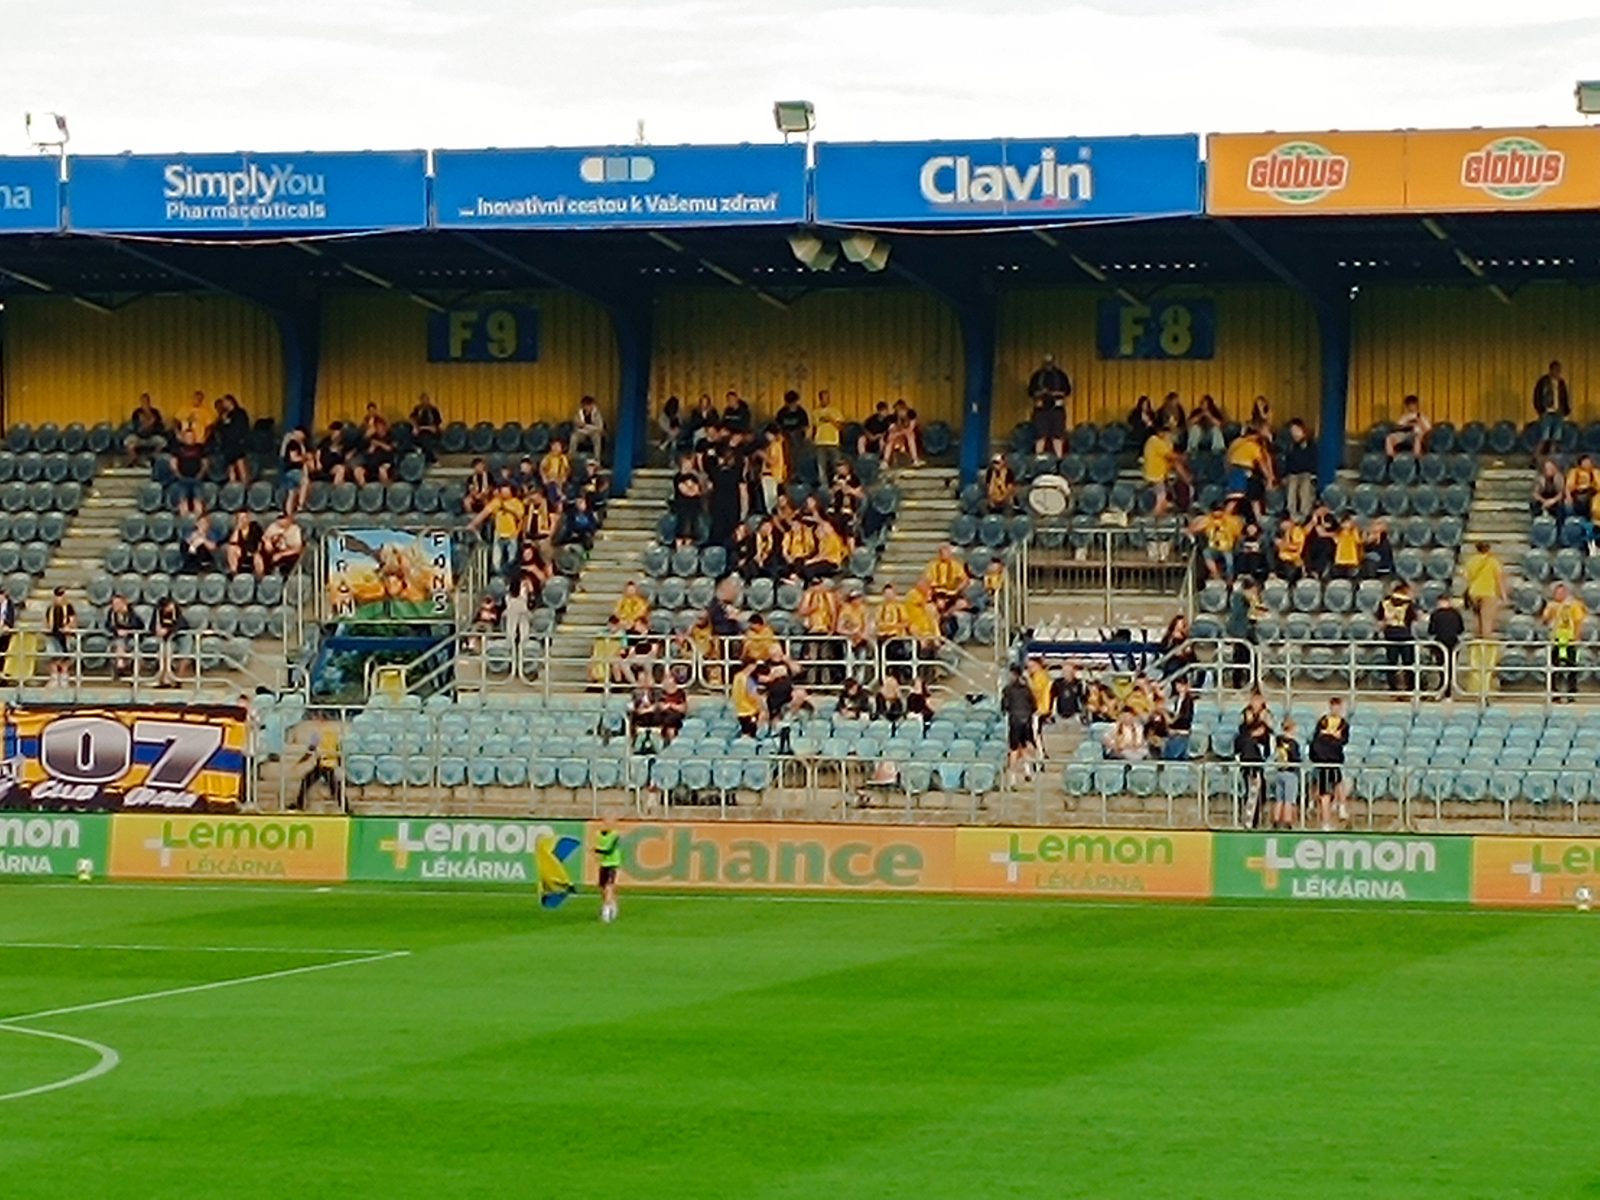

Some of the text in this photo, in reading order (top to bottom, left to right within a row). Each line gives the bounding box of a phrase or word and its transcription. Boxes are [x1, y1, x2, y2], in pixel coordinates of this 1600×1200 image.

[164, 164, 325, 203] SimplyYou
[920, 148, 1092, 204] Clavin
[1252, 153, 1346, 188] Globus
[1463, 151, 1562, 184] Globus
[166, 202, 326, 219] Pharmaceuticals
[630, 196, 642, 213] k
[42, 716, 224, 788] 07
[162, 820, 314, 850] Lemon
[1009, 833, 1174, 865] Lemon
[421, 856, 527, 880] LÉKÁRNA
[620, 825, 924, 887] Chance
[1265, 837, 1436, 872] Lemon
[1532, 844, 1600, 875] Le
[1292, 873, 1406, 899] LÉKÁRNA
